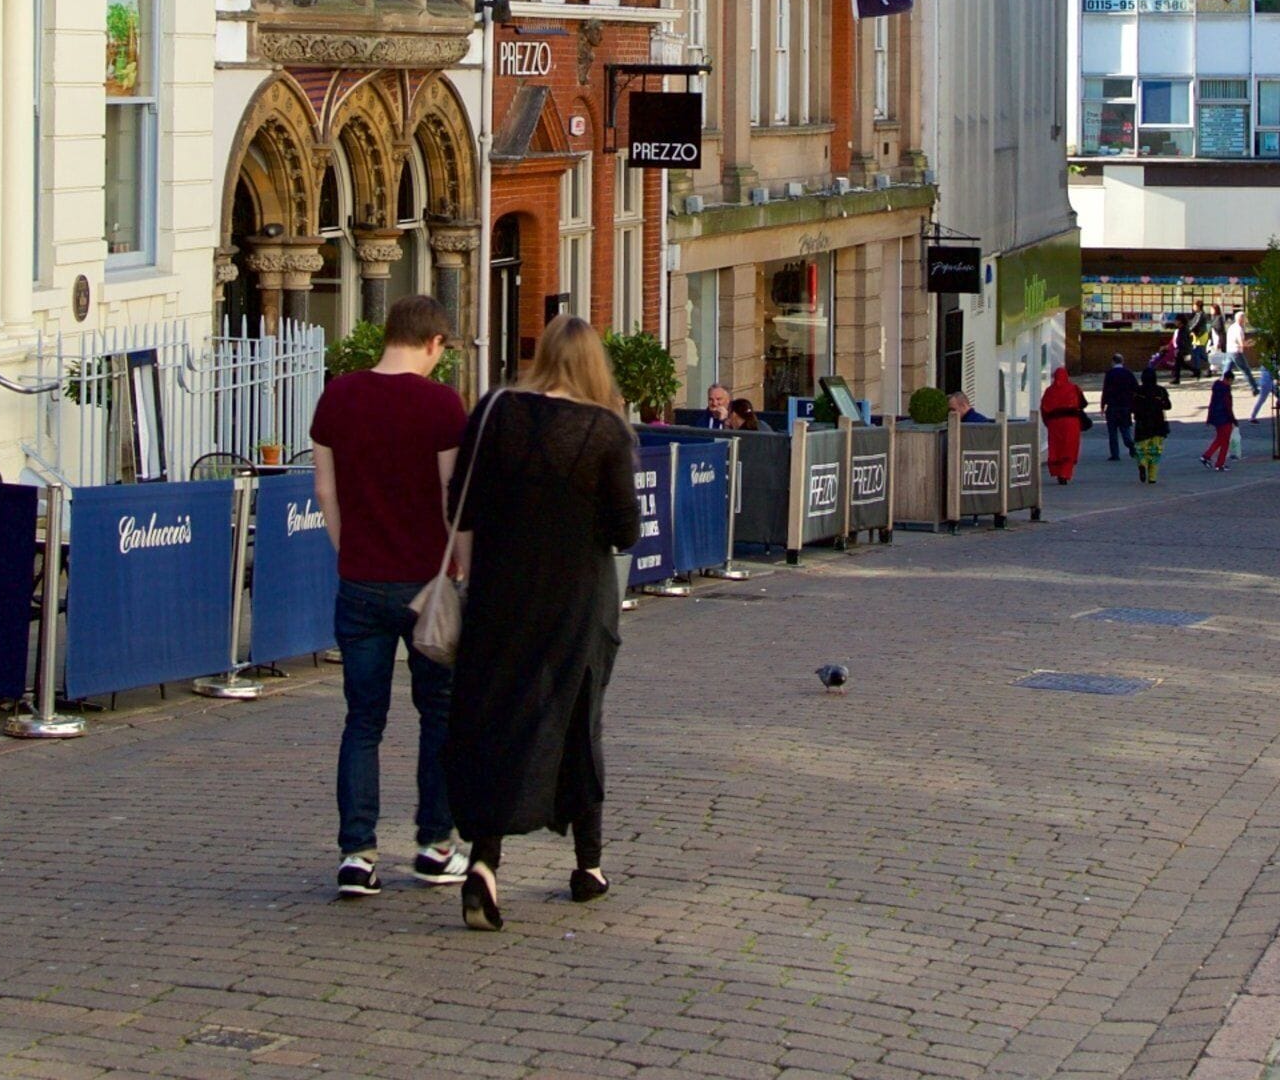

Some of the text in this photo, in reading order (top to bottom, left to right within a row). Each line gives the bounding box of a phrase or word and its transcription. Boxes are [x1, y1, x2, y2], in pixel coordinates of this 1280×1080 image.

[500, 41, 552, 75] PREZZO
[632, 142, 698, 162] PREZZO
[852, 464, 885, 495] PREZZO
[963, 459, 999, 486] PREZZO
[118, 512, 192, 554] Carluccio's
